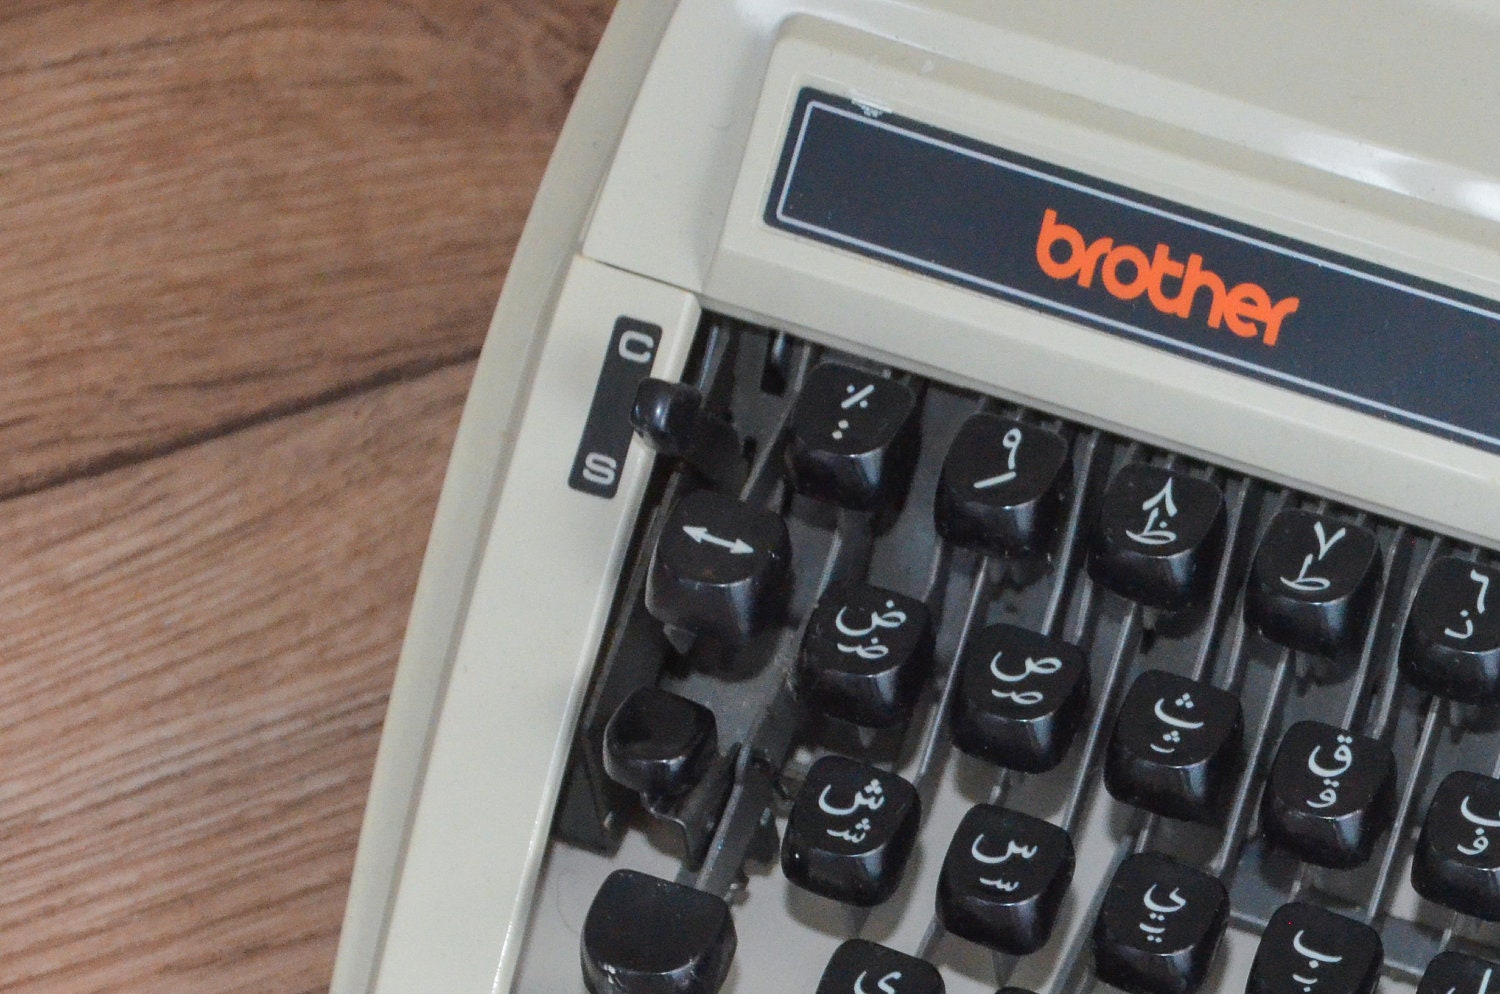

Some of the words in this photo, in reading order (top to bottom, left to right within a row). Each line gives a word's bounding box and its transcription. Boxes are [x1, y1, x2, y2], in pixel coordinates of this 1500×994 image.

[1036, 208, 1299, 347] brother
[618, 330, 654, 364] C
[582, 451, 617, 486] S
